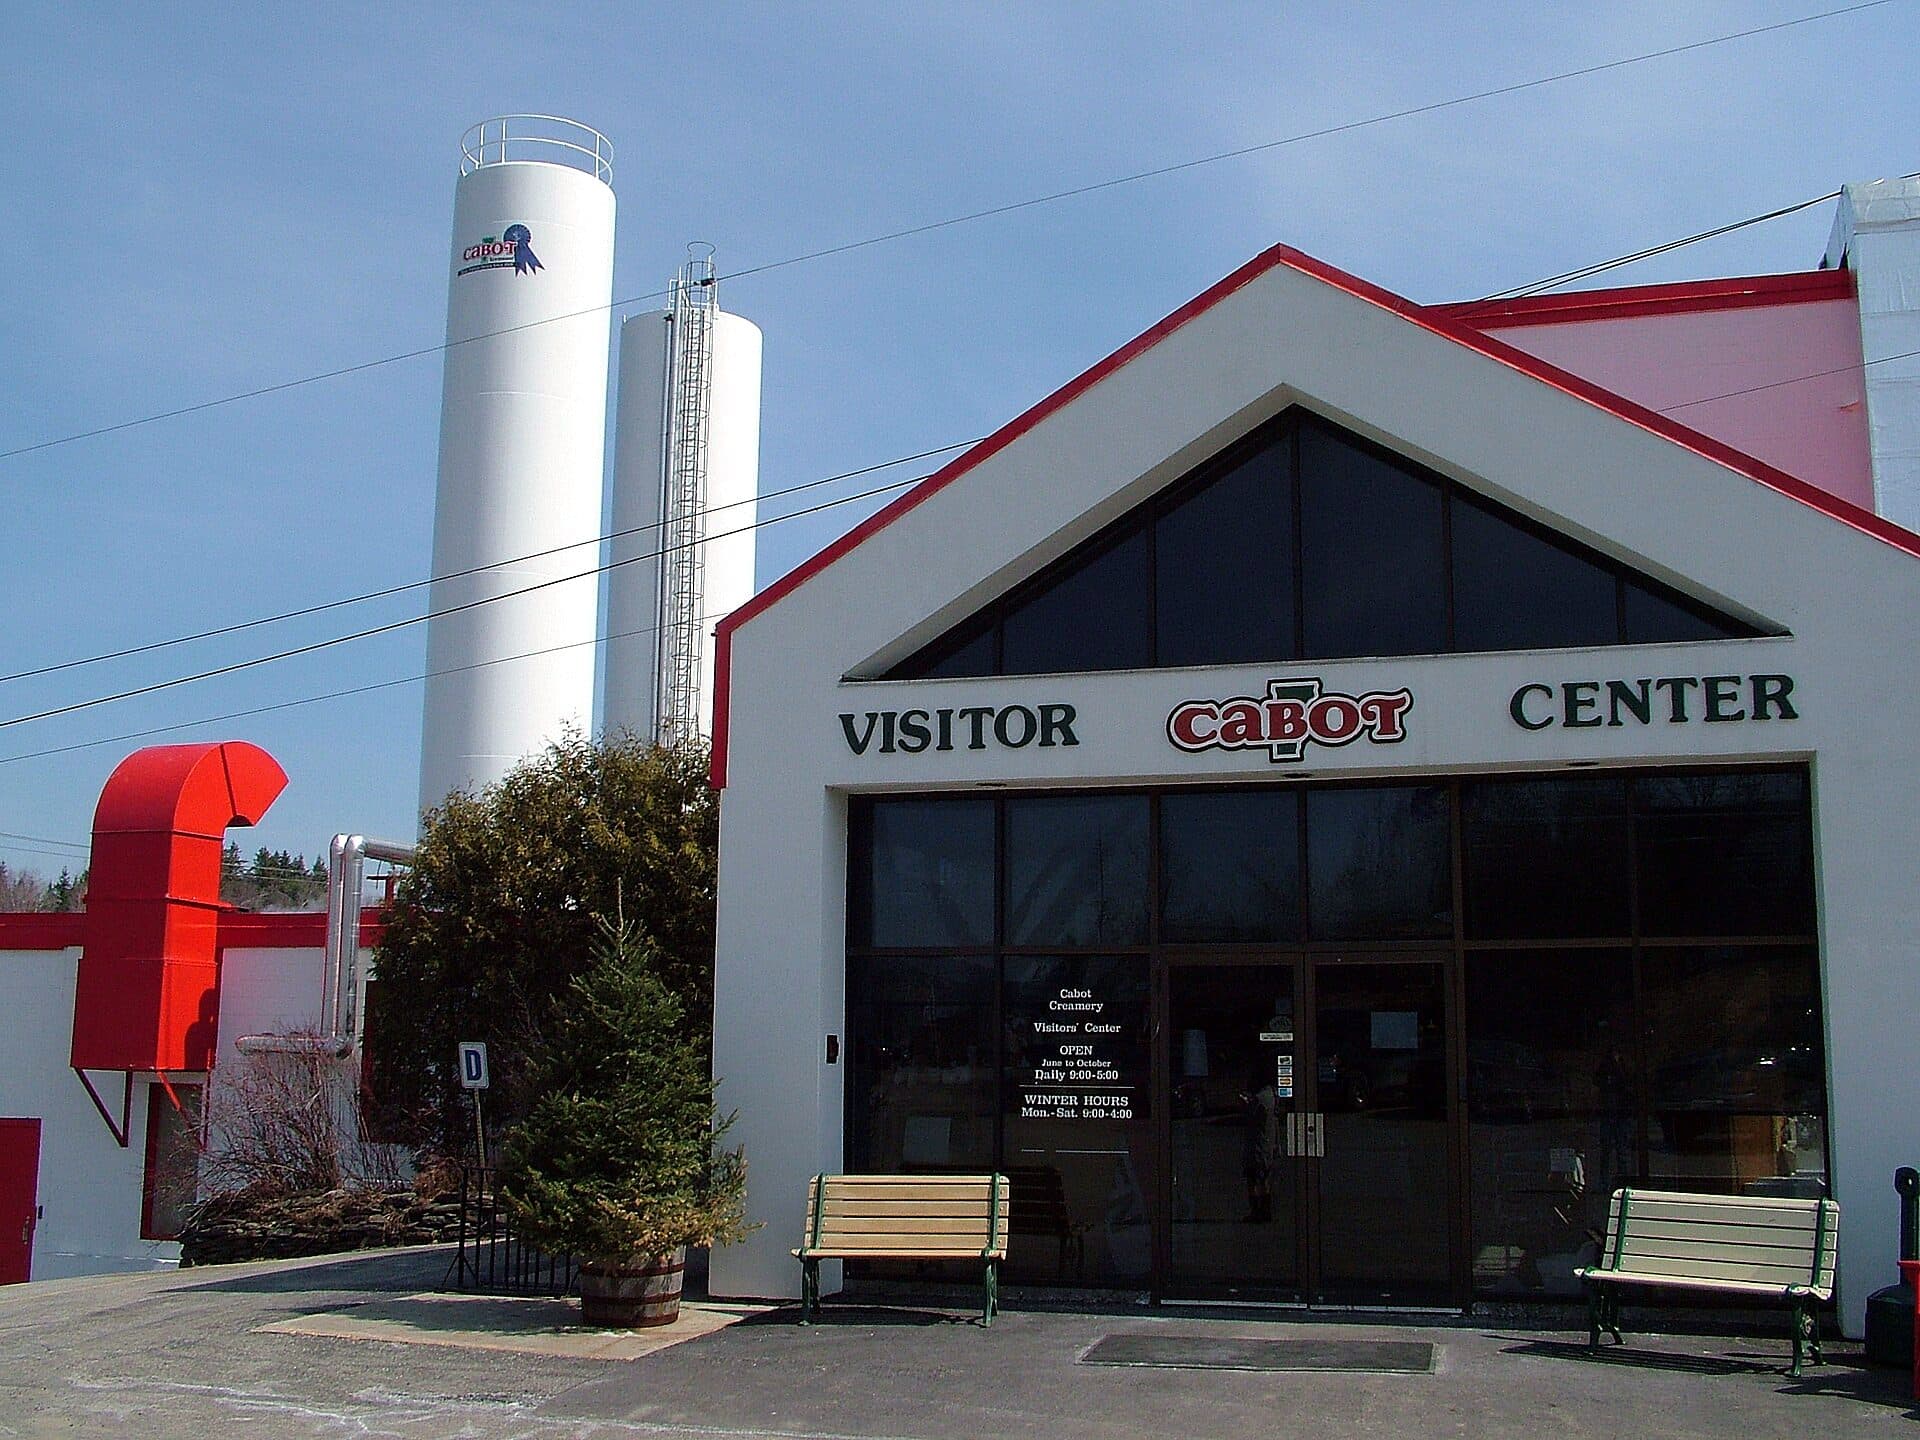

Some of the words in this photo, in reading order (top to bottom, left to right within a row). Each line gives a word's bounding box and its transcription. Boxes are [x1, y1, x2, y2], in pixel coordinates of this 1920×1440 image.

[838, 703, 1080, 755] VISITOR
[1509, 674, 1799, 730] CENTER
[1060, 988, 1092, 999] Cabot
[1049, 1000, 1104, 1013] Creamery
[1084, 1022, 1121, 1033] Center
[1059, 1045, 1093, 1056] OPEN
[464, 1049, 482, 1081] D
[1041, 1058, 1063, 1067] June
[1065, 1059, 1075, 1067] to
[1076, 1059, 1112, 1068] October
[1034, 1069, 1066, 1081] Daily
[1069, 1070, 1119, 1080] 9:00-5:00
[1024, 1094, 1079, 1105] WINTER
[1083, 1095, 1129, 1107] HOURS
[1082, 1108, 1133, 1119] 9:00-4:00
